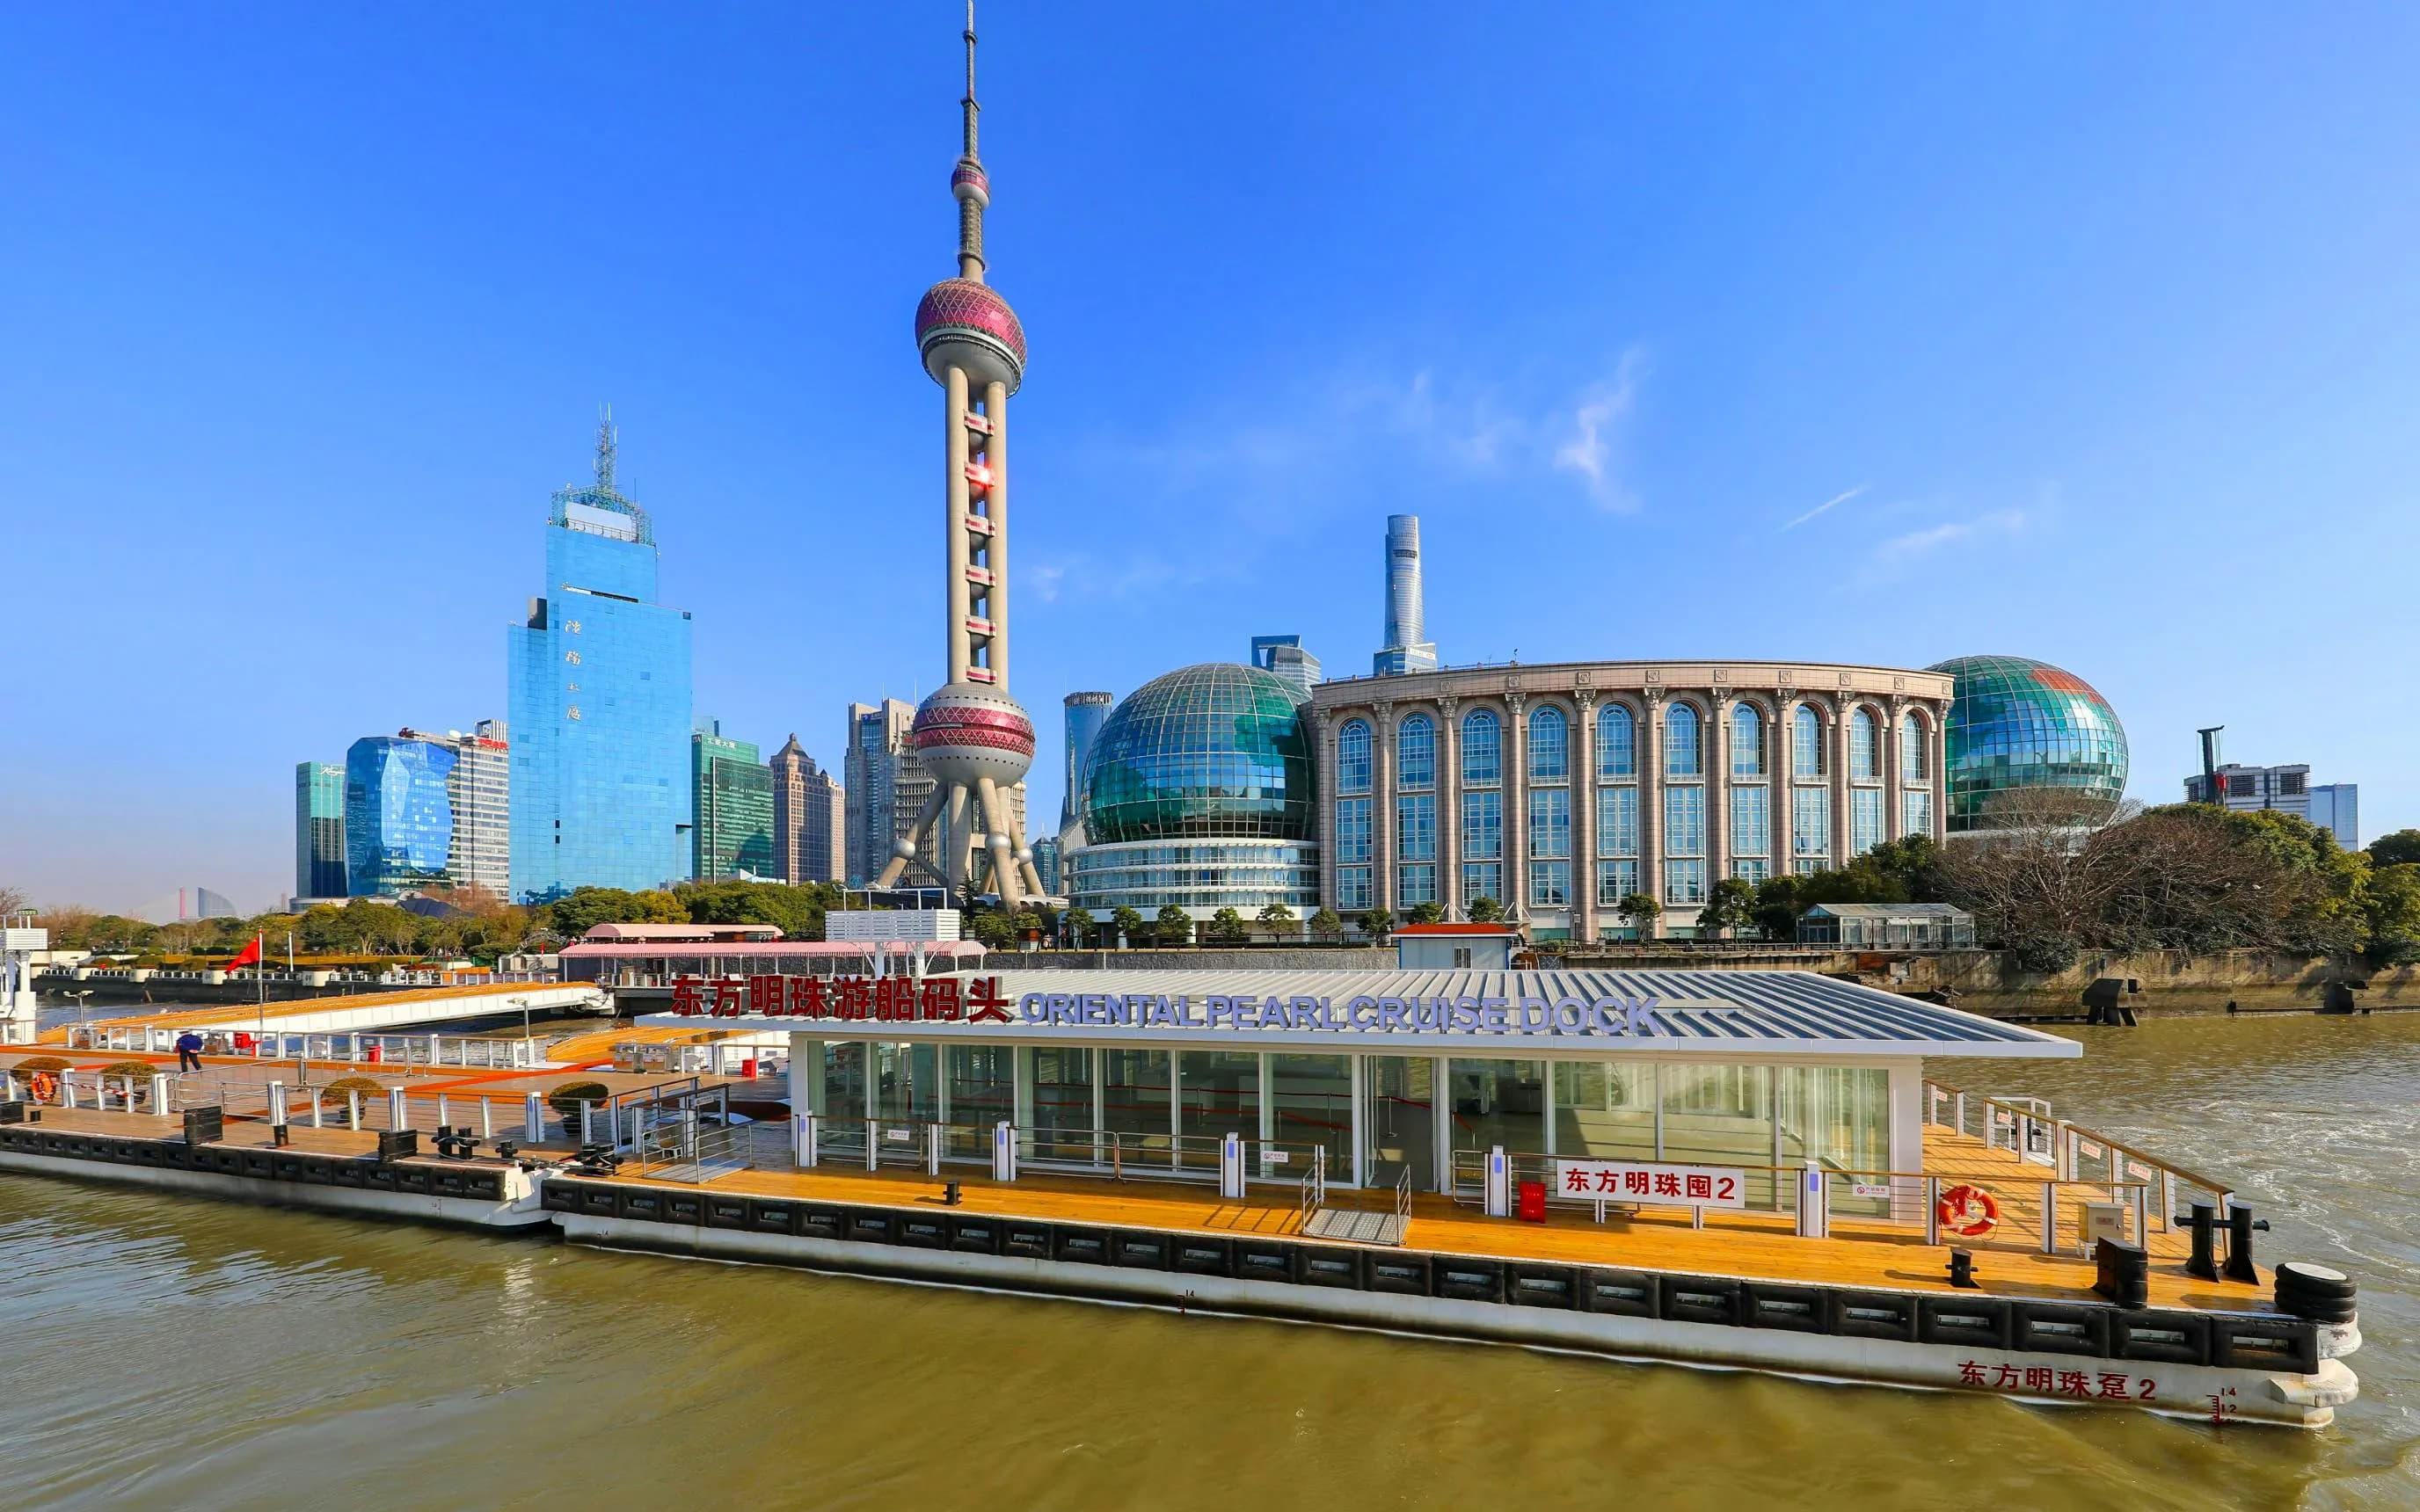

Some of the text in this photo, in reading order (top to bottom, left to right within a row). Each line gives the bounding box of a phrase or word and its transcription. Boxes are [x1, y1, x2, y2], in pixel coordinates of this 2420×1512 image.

[671, 975, 1010, 1022] 东方明珠游船码头
[1020, 992, 1661, 1034] ORIENTAL PEARL CRUISE DOCK
